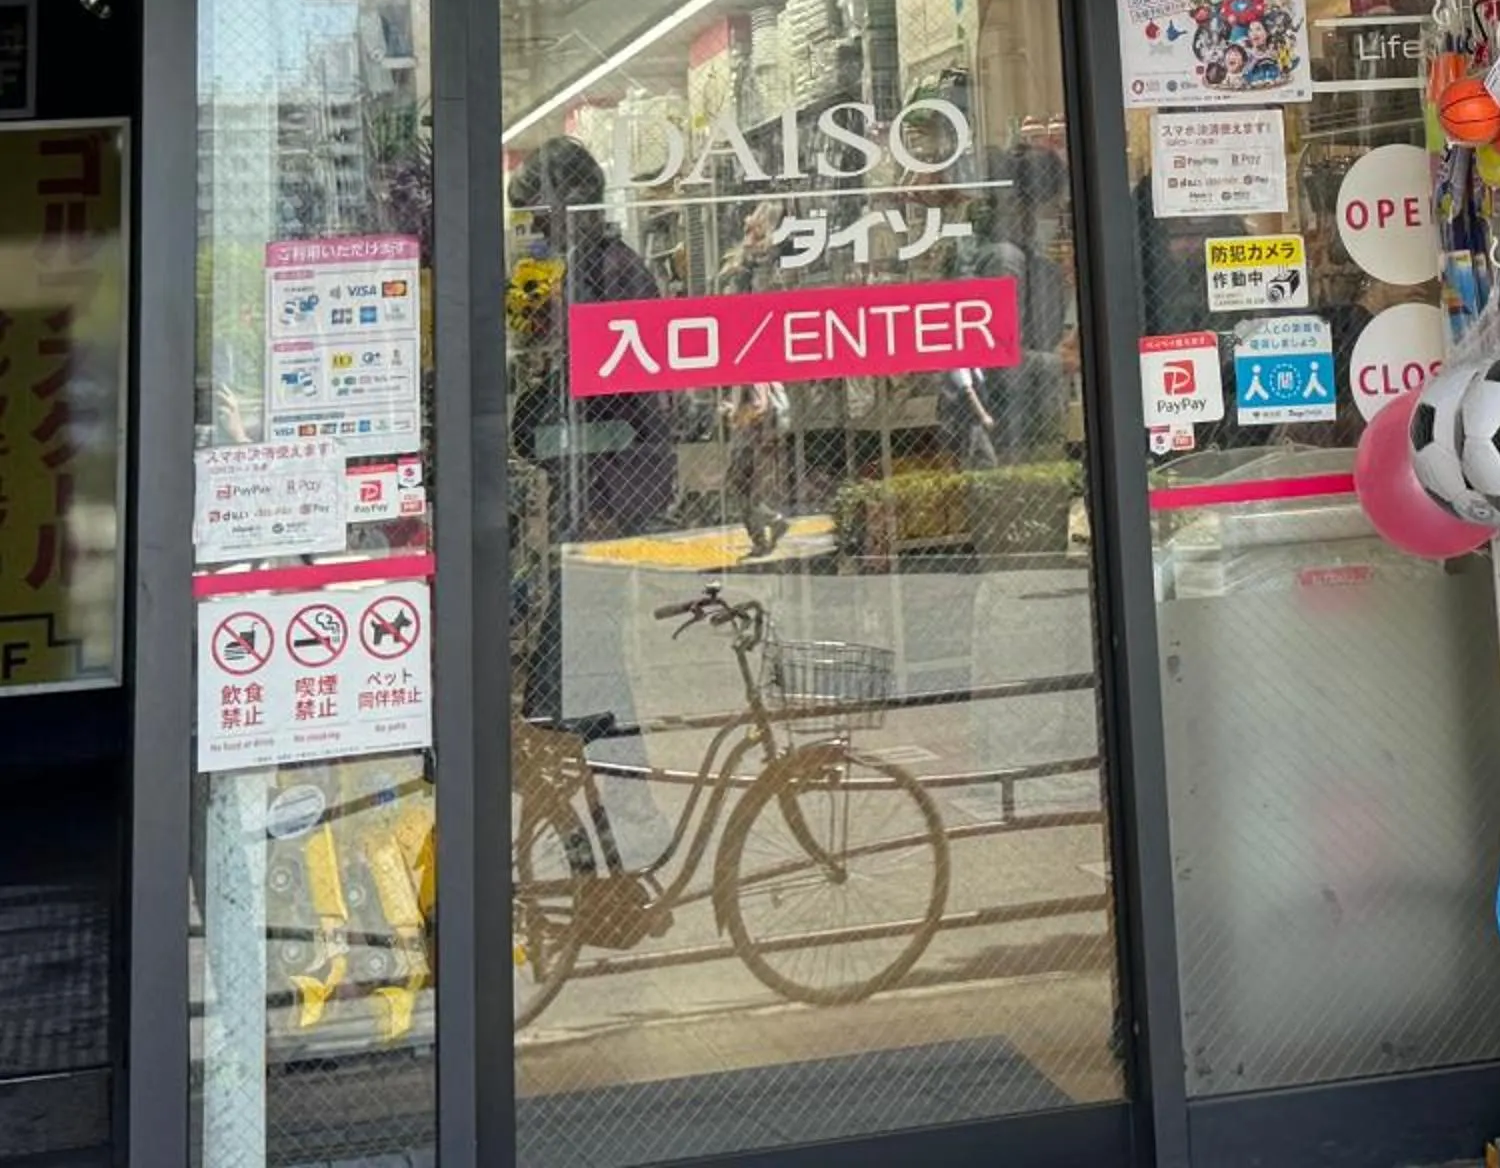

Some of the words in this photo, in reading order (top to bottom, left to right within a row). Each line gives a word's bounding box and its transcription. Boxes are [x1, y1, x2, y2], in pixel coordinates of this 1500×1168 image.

[1359, 34, 1423, 61] Life
[612, 99, 972, 189] DAISO
[1346, 198, 1434, 230] OPE
[773, 207, 974, 269] ダイソー
[1211, 243, 1295, 264] 防犯カメラ
[347, 284, 377, 298] VISA
[1213, 270, 1263, 289] 作動中
[1157, 398, 1207, 414] PayPay
[294, 675, 339, 698] 喫煙
[367, 668, 414, 686] ペット
[221, 682, 264, 704] 飲食
[357, 687, 423, 711] 同伴禁止
[221, 705, 265, 729] 禁止
[294, 698, 339, 721] 禁止
